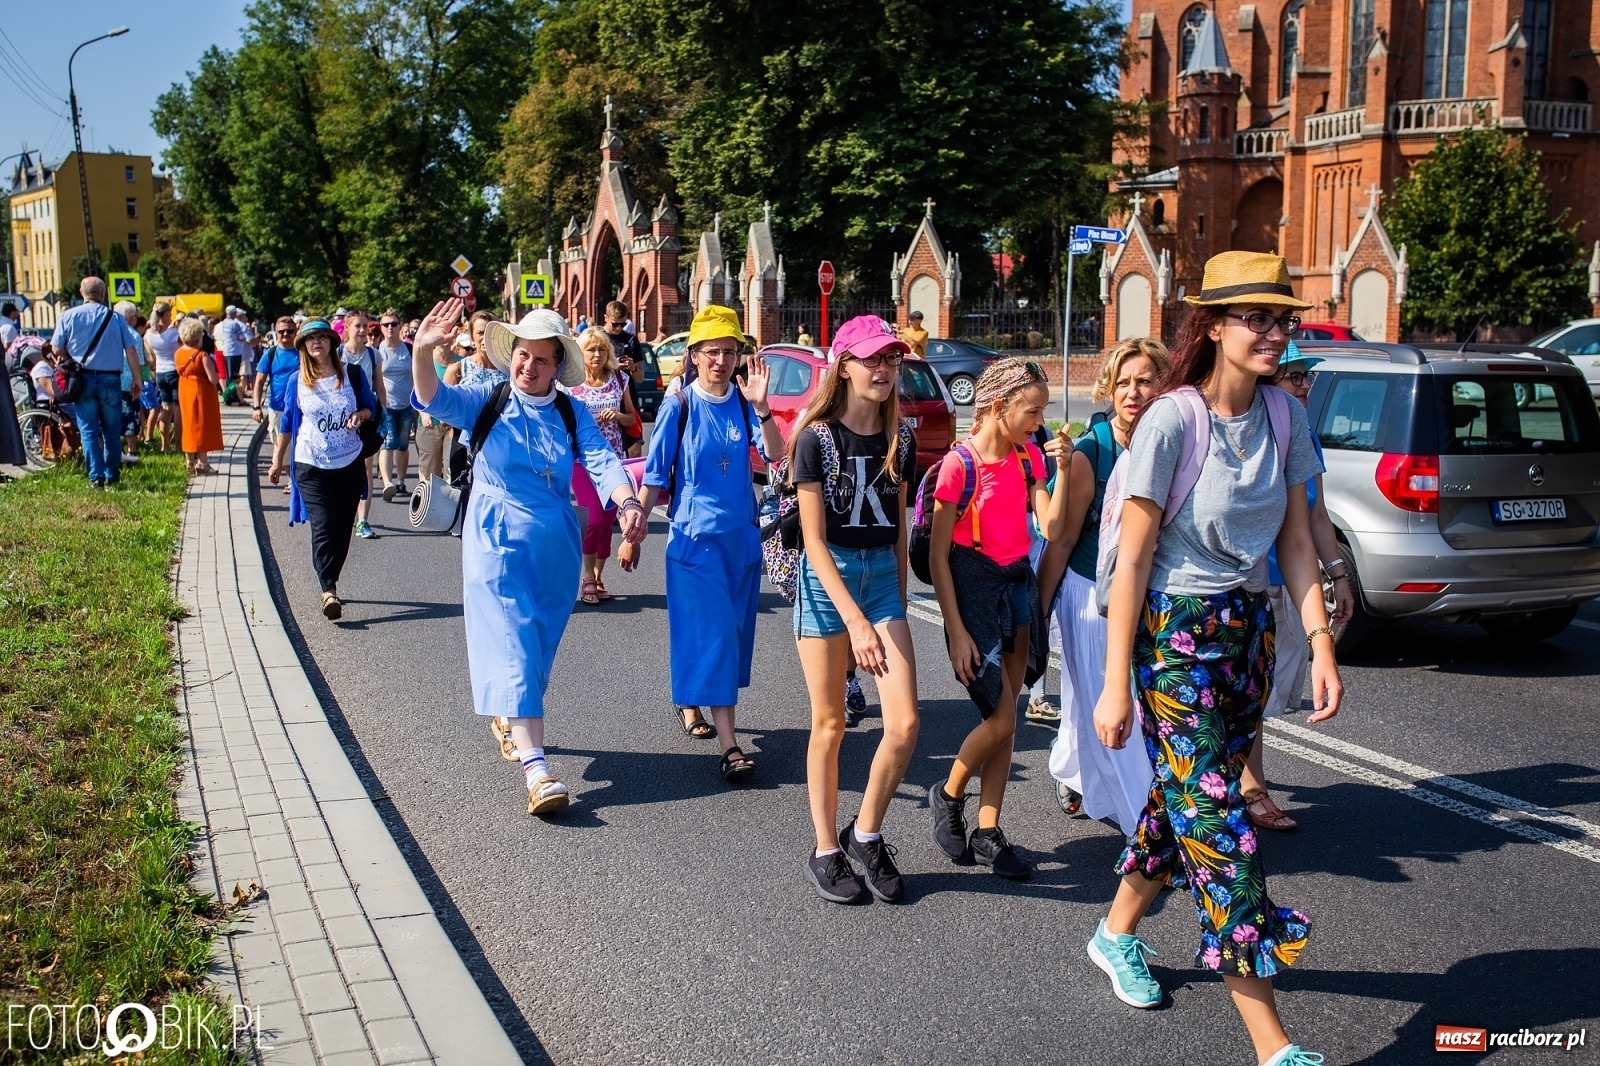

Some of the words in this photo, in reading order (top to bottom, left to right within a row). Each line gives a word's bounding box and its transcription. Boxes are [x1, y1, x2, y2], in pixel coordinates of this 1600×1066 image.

[821, 272, 833, 283] STOP
[318, 412, 347, 433] Olal
[834, 485, 854, 497] lvin
[1502, 502, 1522, 519] SG
[1525, 500, 1565, 518] 3270R
